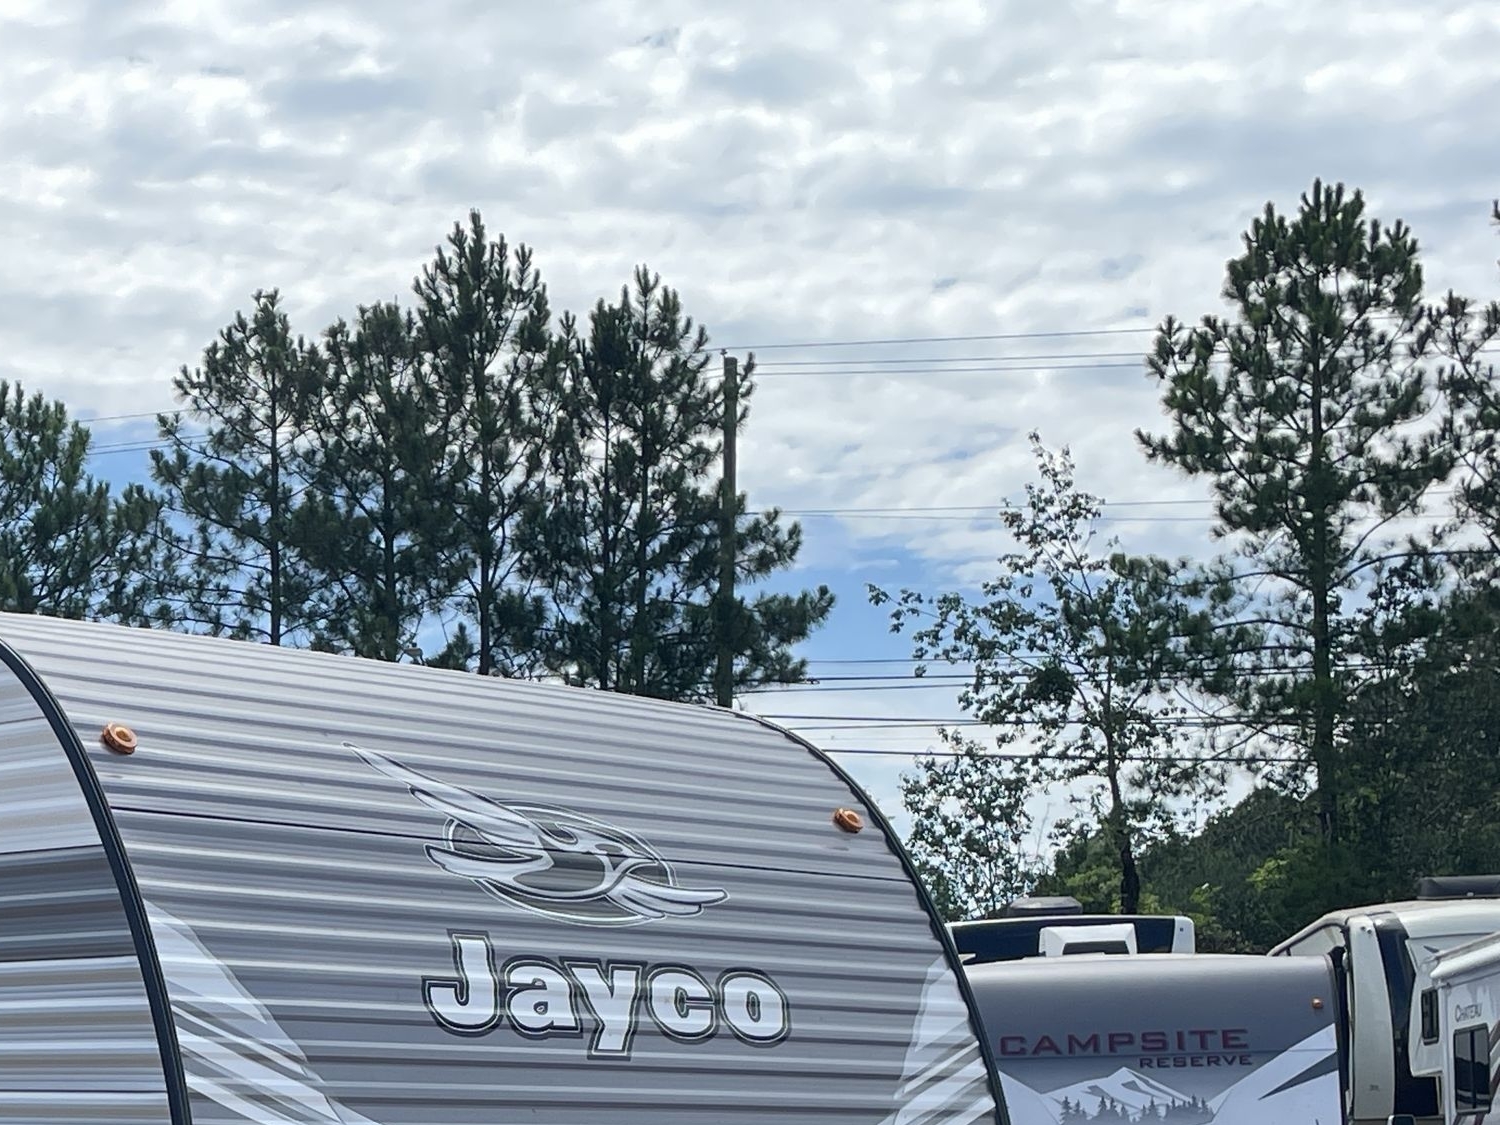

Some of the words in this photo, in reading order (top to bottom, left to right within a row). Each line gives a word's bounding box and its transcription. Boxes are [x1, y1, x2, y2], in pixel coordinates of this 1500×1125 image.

[420, 928, 792, 1061] Jayco
[1000, 1028, 1249, 1057] CAMPSITE
[1139, 1054, 1252, 1069] RESERVE
